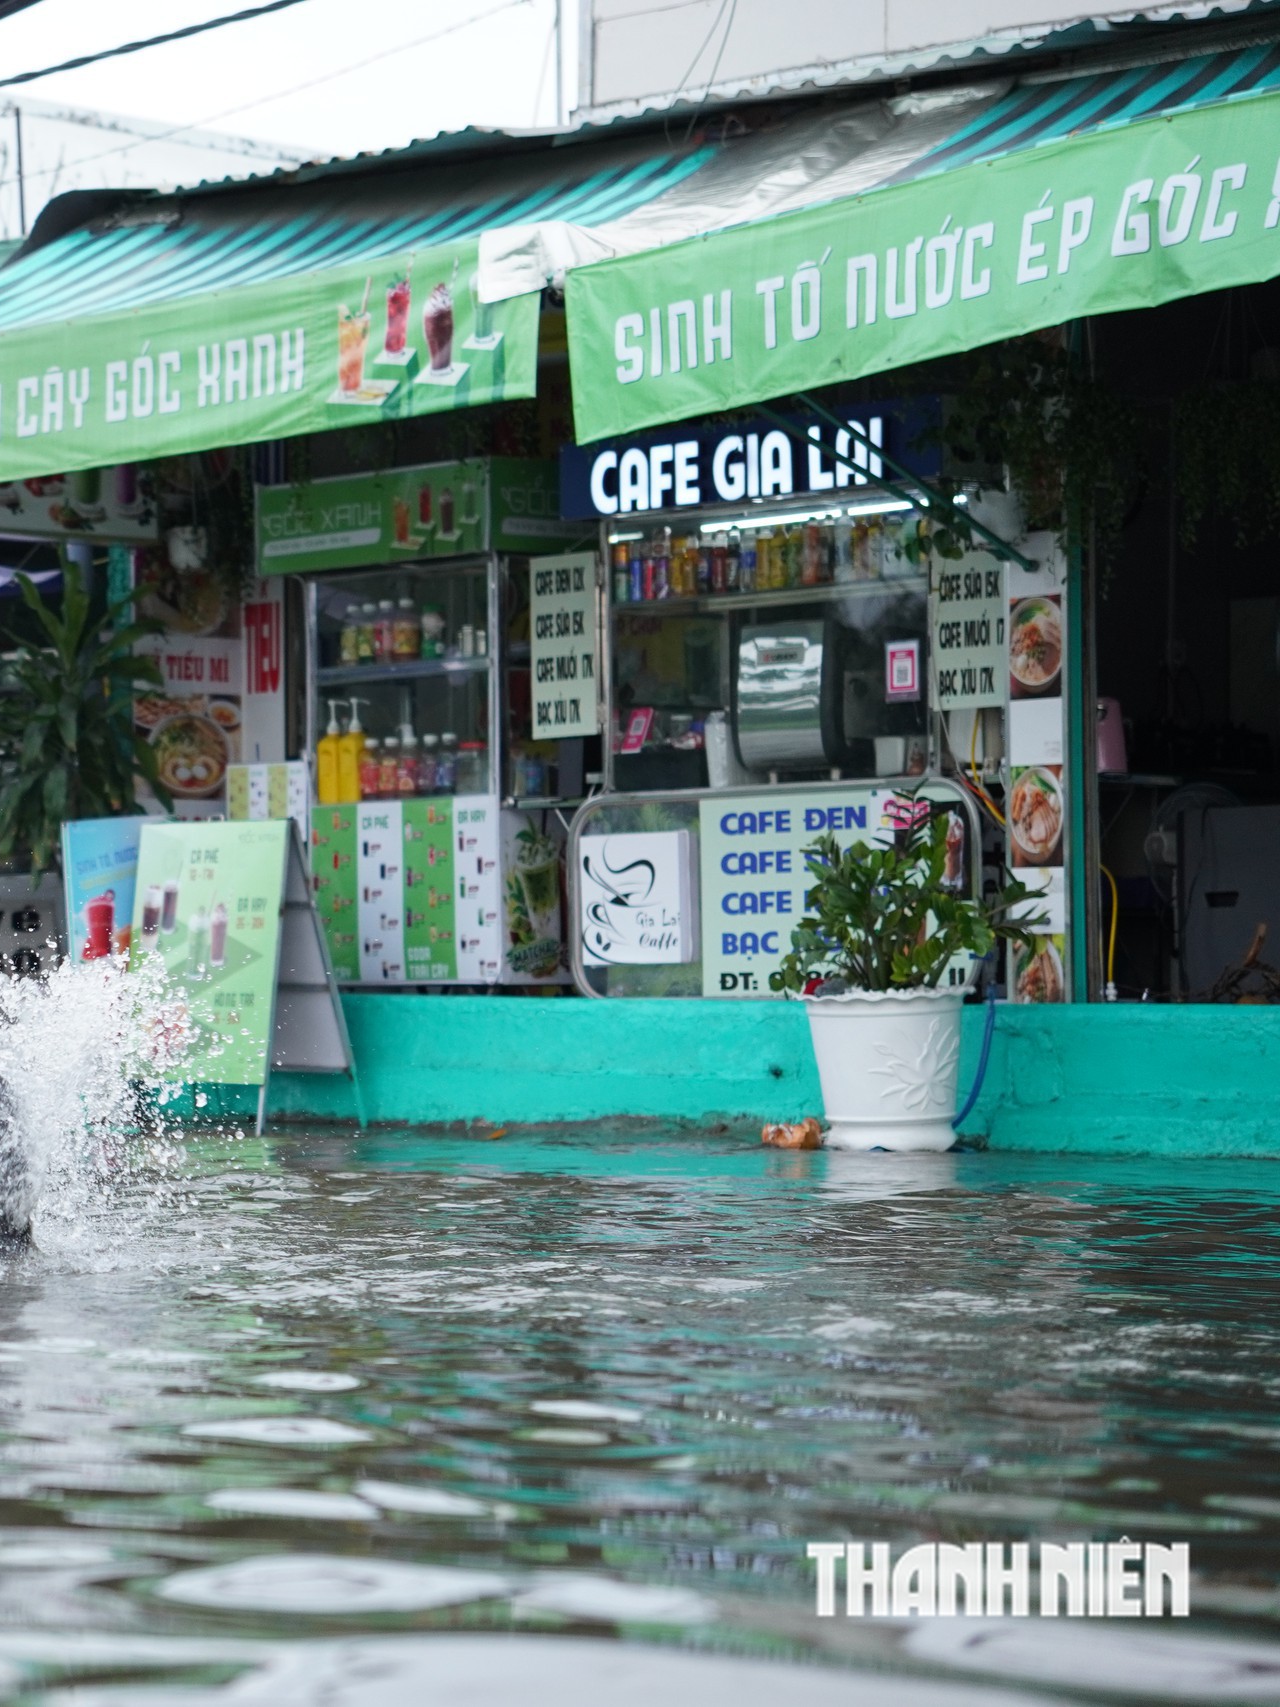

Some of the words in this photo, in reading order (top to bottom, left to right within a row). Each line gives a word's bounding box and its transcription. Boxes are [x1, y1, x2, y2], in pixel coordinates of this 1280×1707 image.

[615, 289, 732, 384] SINH
[756, 246, 832, 350] TỐ
[846, 214, 994, 329] NƯỚC
[1017, 188, 1094, 285] ÉP
[1111, 154, 1247, 257] GÓC
[17, 366, 90, 438] CÂY
[105, 339, 181, 423] GÓC
[197, 327, 305, 408] XANH
[590, 440, 700, 515] CAFE
[712, 430, 793, 501] GIA
[808, 416, 882, 491] LAI
[321, 502, 381, 530] XANH
[535, 570, 553, 596] CAFE
[939, 574, 961, 602] CAFE
[536, 613, 553, 640] CAFE
[939, 620, 961, 649] CAFE
[537, 656, 554, 683] CAFE
[939, 669, 957, 703] BẠC
[980, 667, 994, 694] 17K
[537, 700, 552, 732] BẠC
[720, 810, 791, 836] CAFE
[803, 806, 867, 832] ĐEN
[720, 851, 792, 876] CAFE
[721, 891, 793, 916] CAFE
[636, 911, 655, 927] Gia
[721, 931, 779, 960] BẠC
[720, 972, 758, 991] ĐT:
